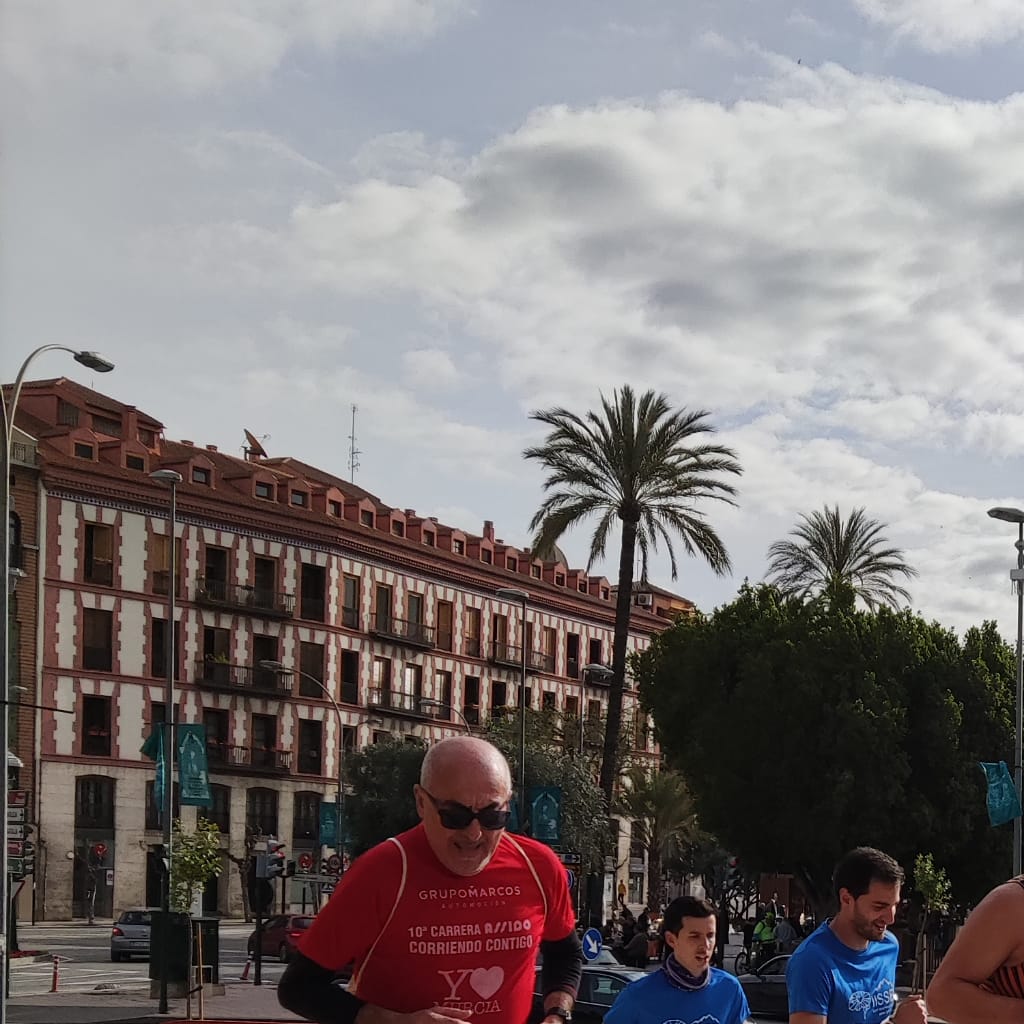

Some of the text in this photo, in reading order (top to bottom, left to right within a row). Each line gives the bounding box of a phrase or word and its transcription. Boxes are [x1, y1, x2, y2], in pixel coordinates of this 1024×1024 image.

[408, 926, 428, 938] 10ª
[430, 924, 482, 937] CARRERA
[409, 935, 533, 955] CORRIENDO CONTIGO
[437, 968, 474, 1001] Y
